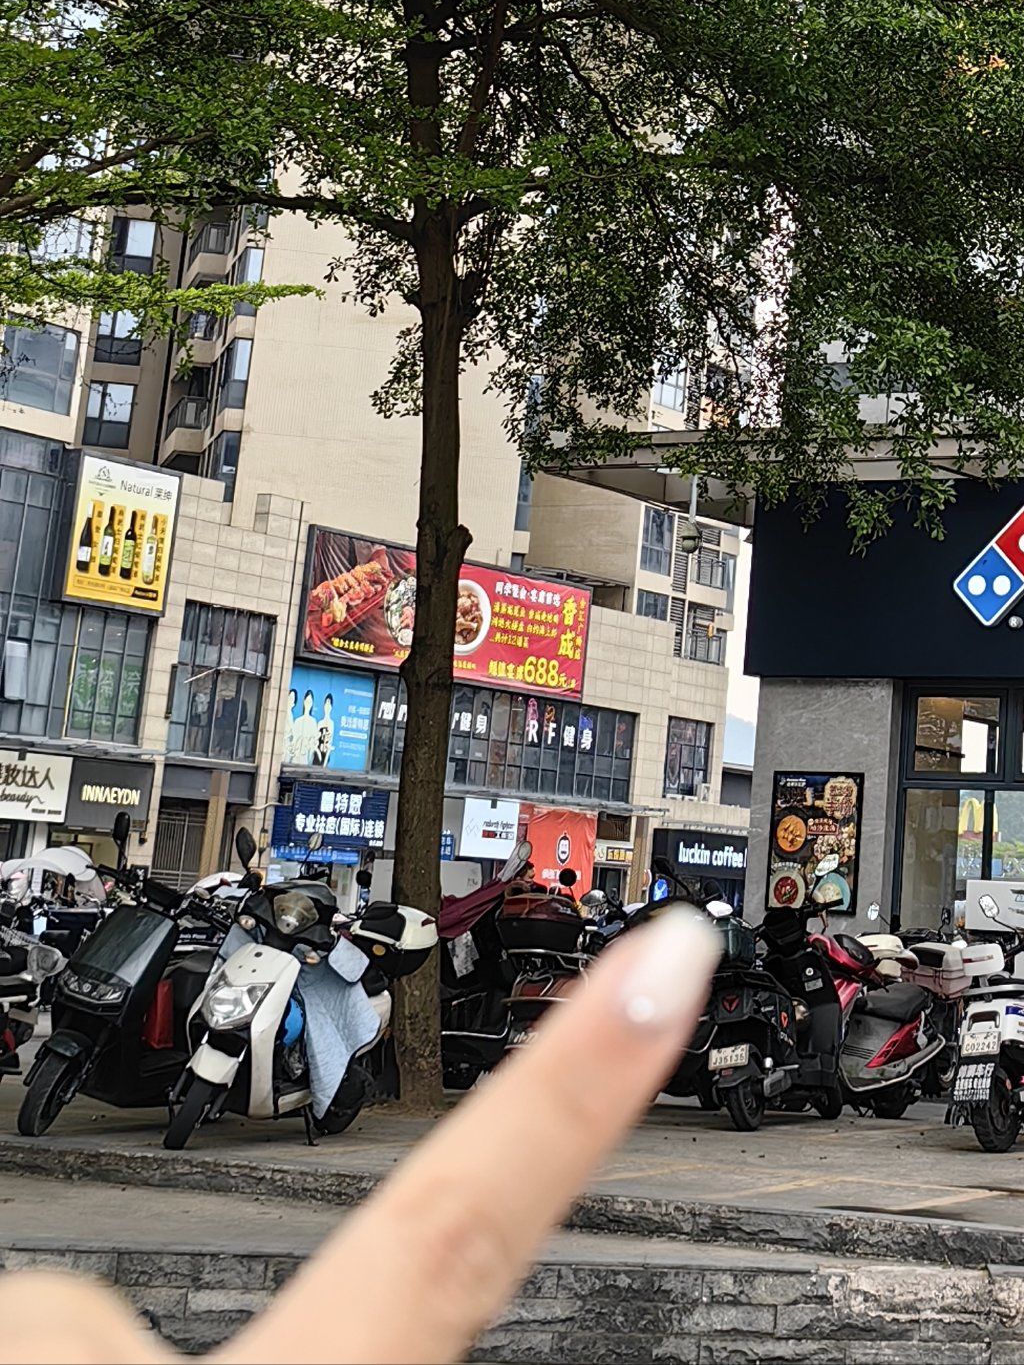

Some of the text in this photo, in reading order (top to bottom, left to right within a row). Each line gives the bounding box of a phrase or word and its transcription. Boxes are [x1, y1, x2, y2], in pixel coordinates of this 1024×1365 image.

[120, 480, 153, 497] Natural
[678, 841, 743, 868] luckin coffee
